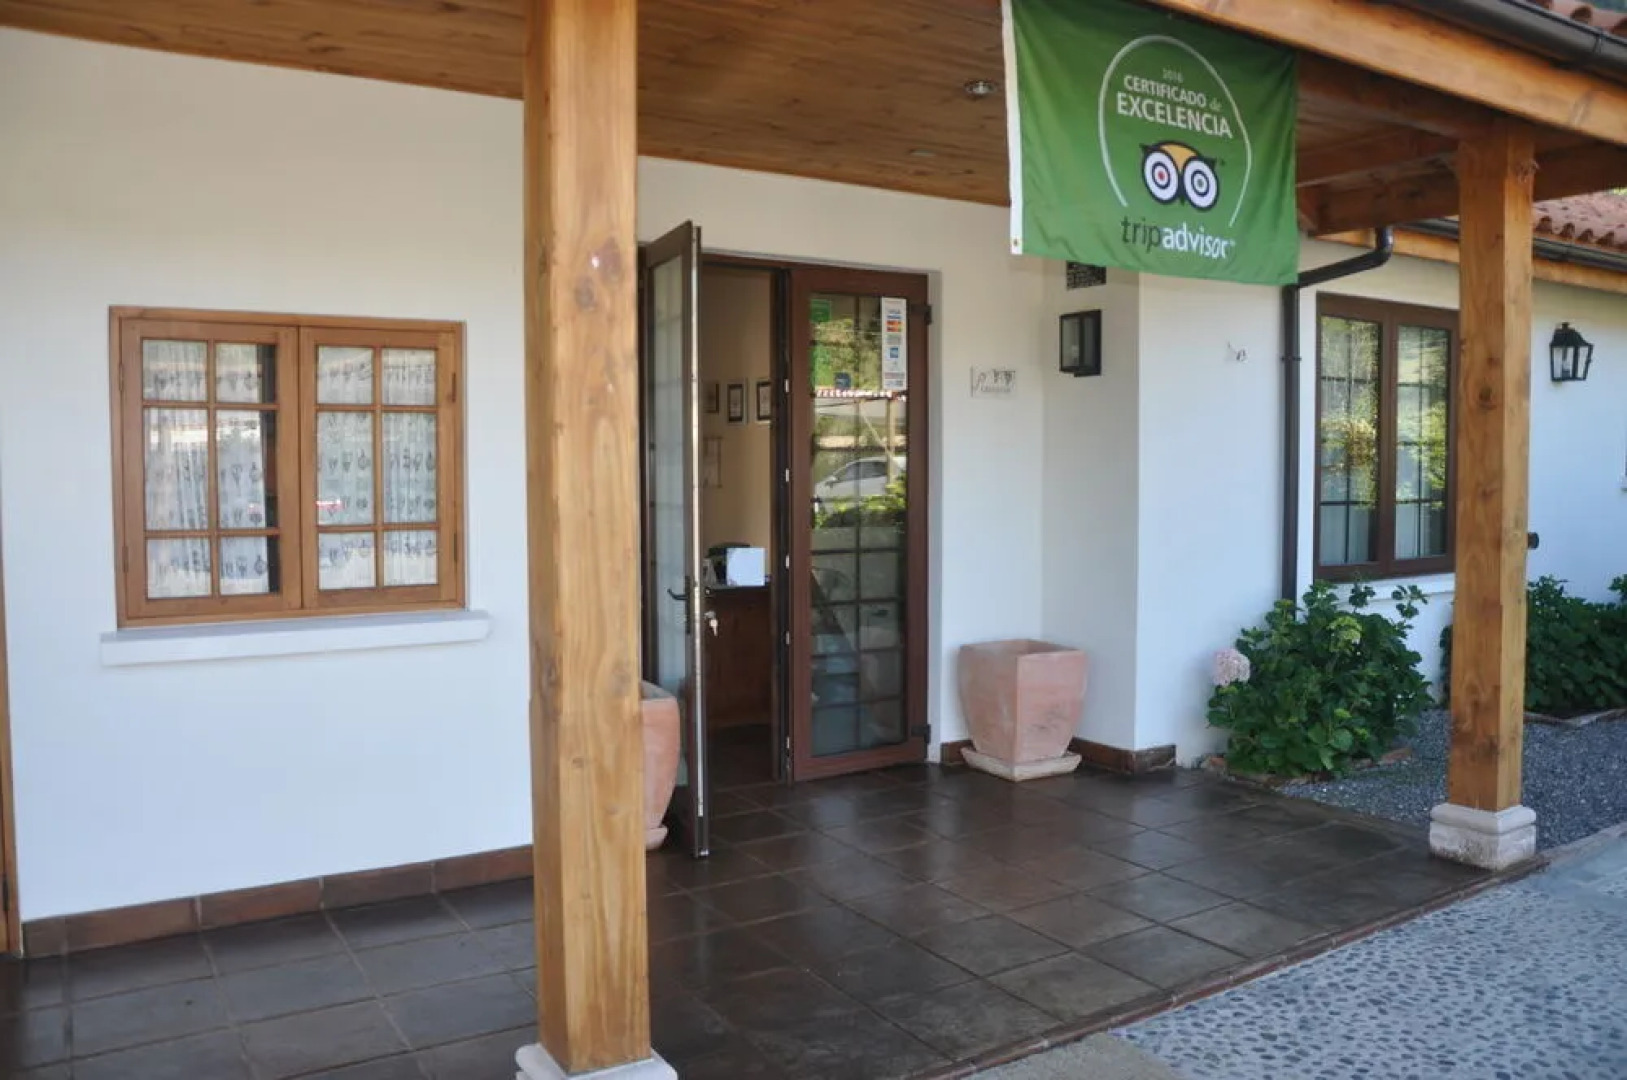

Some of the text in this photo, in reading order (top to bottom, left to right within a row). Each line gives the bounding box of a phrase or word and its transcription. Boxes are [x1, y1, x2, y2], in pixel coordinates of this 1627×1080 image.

[1123, 74, 1222, 110] CERTIFICADO de
[1117, 93, 1233, 138] EXCELENCIA
[1121, 216, 1230, 259] tripadvisor
